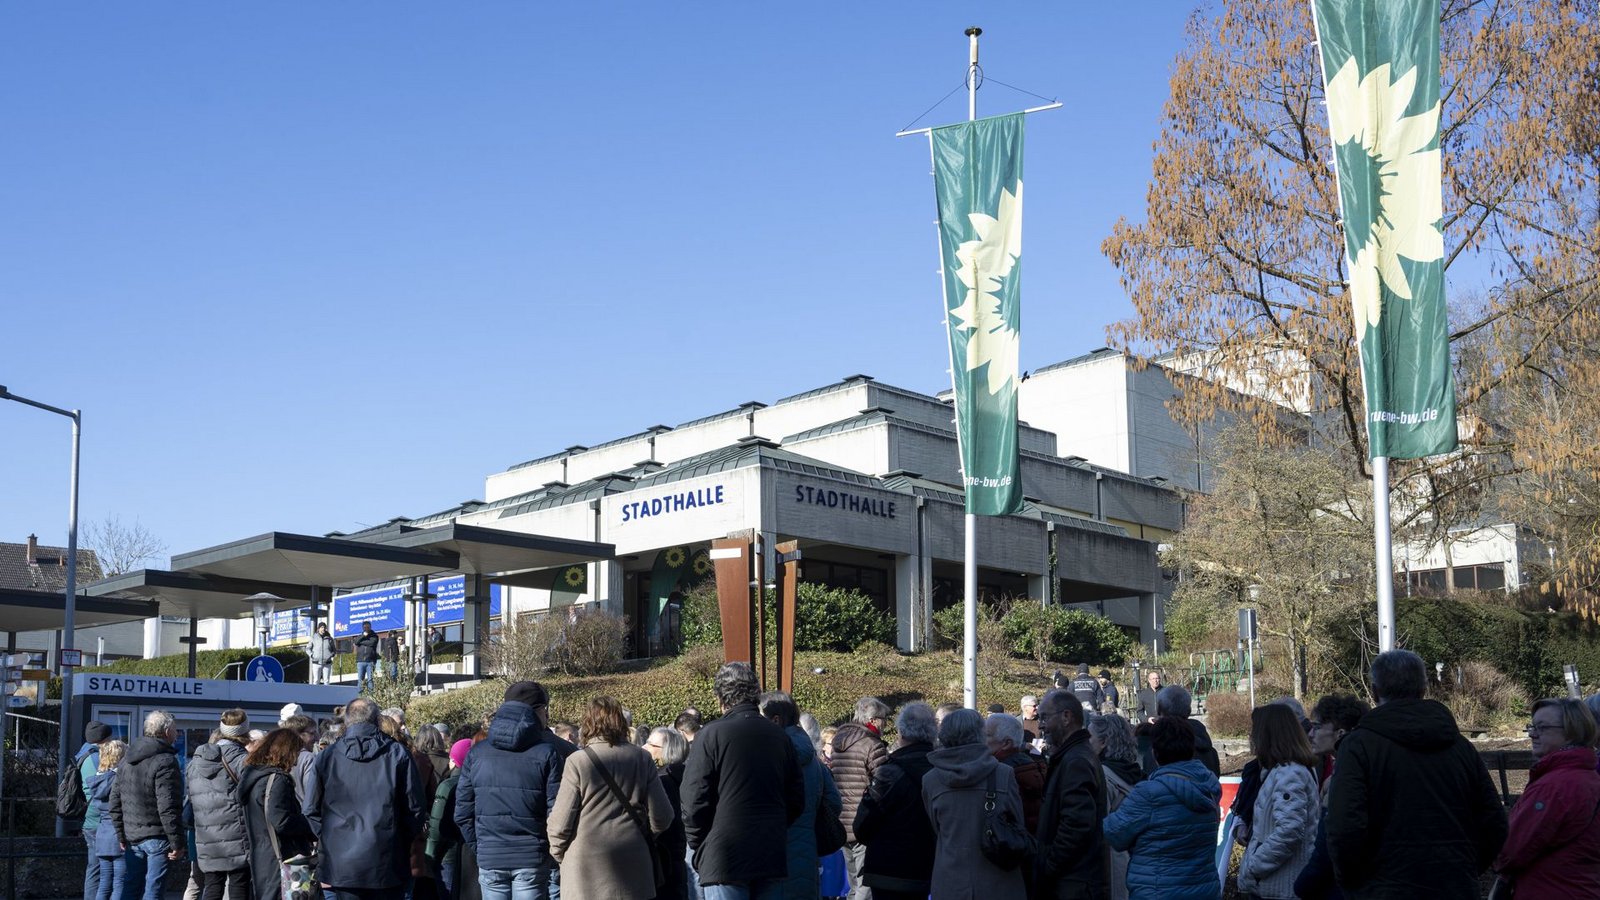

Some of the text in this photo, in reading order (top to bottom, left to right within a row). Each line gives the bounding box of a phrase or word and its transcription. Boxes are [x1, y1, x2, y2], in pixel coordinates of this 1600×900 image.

[622, 485, 724, 522] STADTHALLE
[796, 484, 896, 519] STADTHALLE
[89, 677, 203, 695] STADTHALLE
